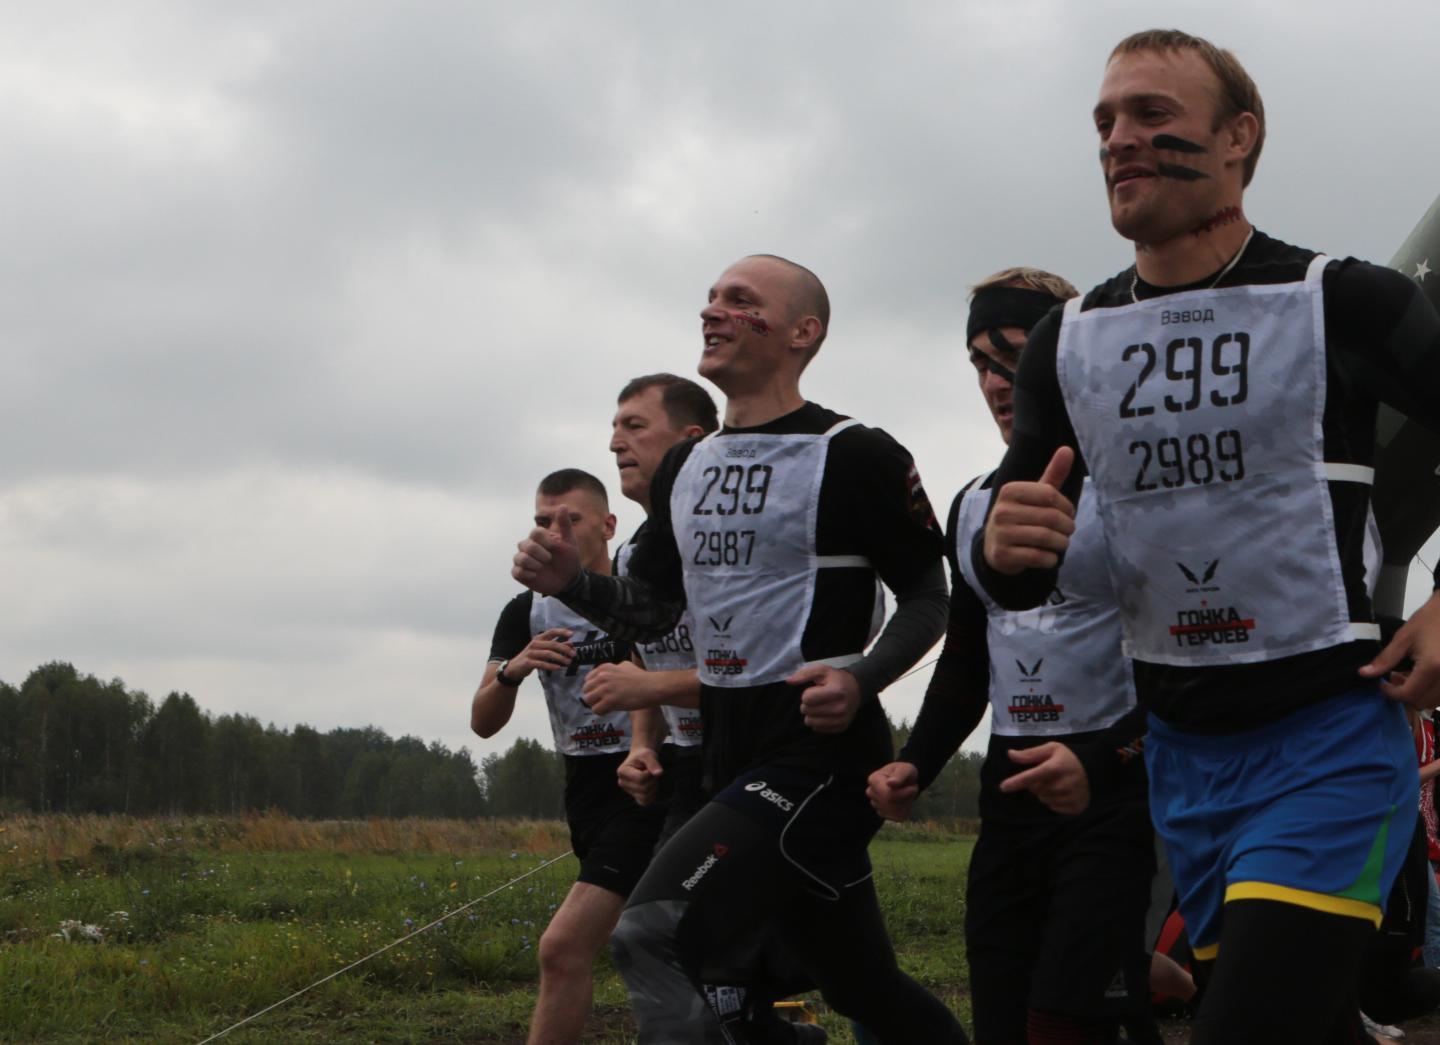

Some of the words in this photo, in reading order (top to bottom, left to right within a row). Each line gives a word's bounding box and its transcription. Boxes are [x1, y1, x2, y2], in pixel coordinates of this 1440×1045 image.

[1161, 308, 1214, 325] Взвод
[1119, 331, 1250, 419] 299
[1128, 429, 1246, 492] 2989
[693, 463, 773, 515] 299
[694, 530, 756, 566] 2987
[1176, 606, 1243, 627] ГОНКА
[1176, 626, 1249, 647] ГЕРОЕВ
[1012, 694, 1054, 707] ГОНКА
[760, 788, 795, 811] asics
[682, 854, 719, 891] Reebok
